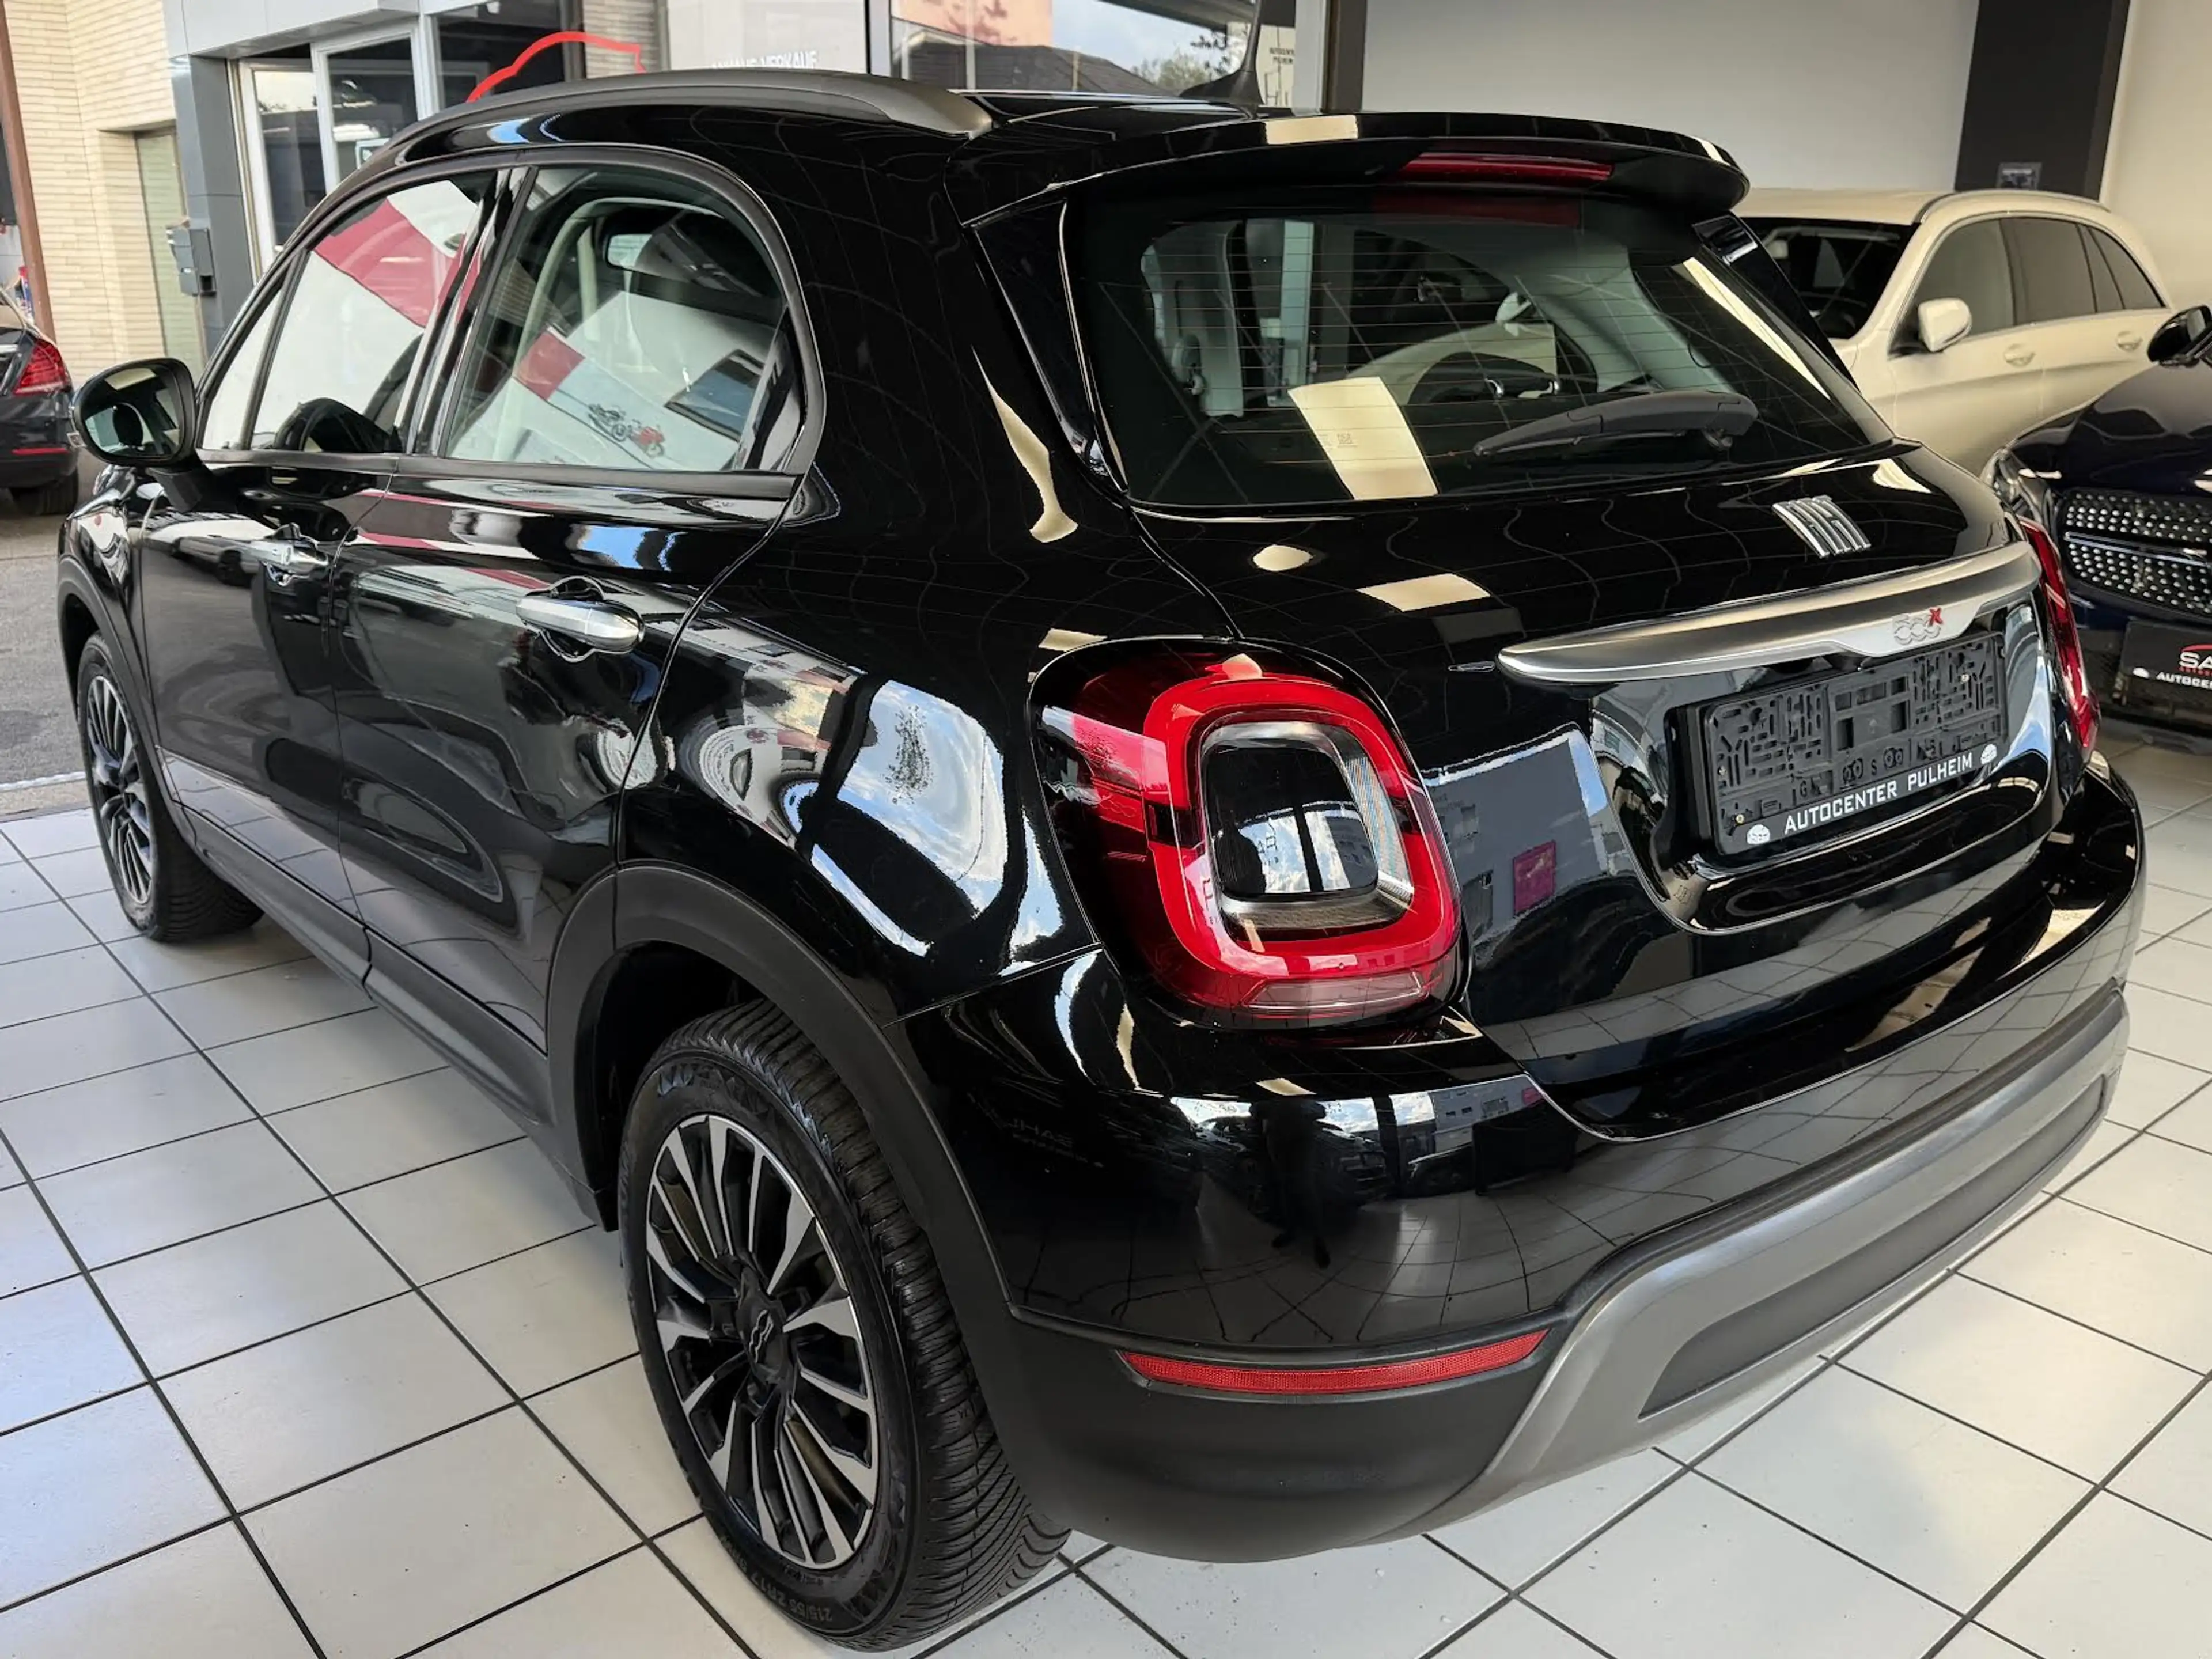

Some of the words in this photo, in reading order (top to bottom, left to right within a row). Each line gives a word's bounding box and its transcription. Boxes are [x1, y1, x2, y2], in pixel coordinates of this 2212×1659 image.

[2156, 671, 2212, 690] AUTOCE
[1784, 780, 1897, 835] AUTOCENTER
[1908, 752, 1973, 791] PULHEIM
